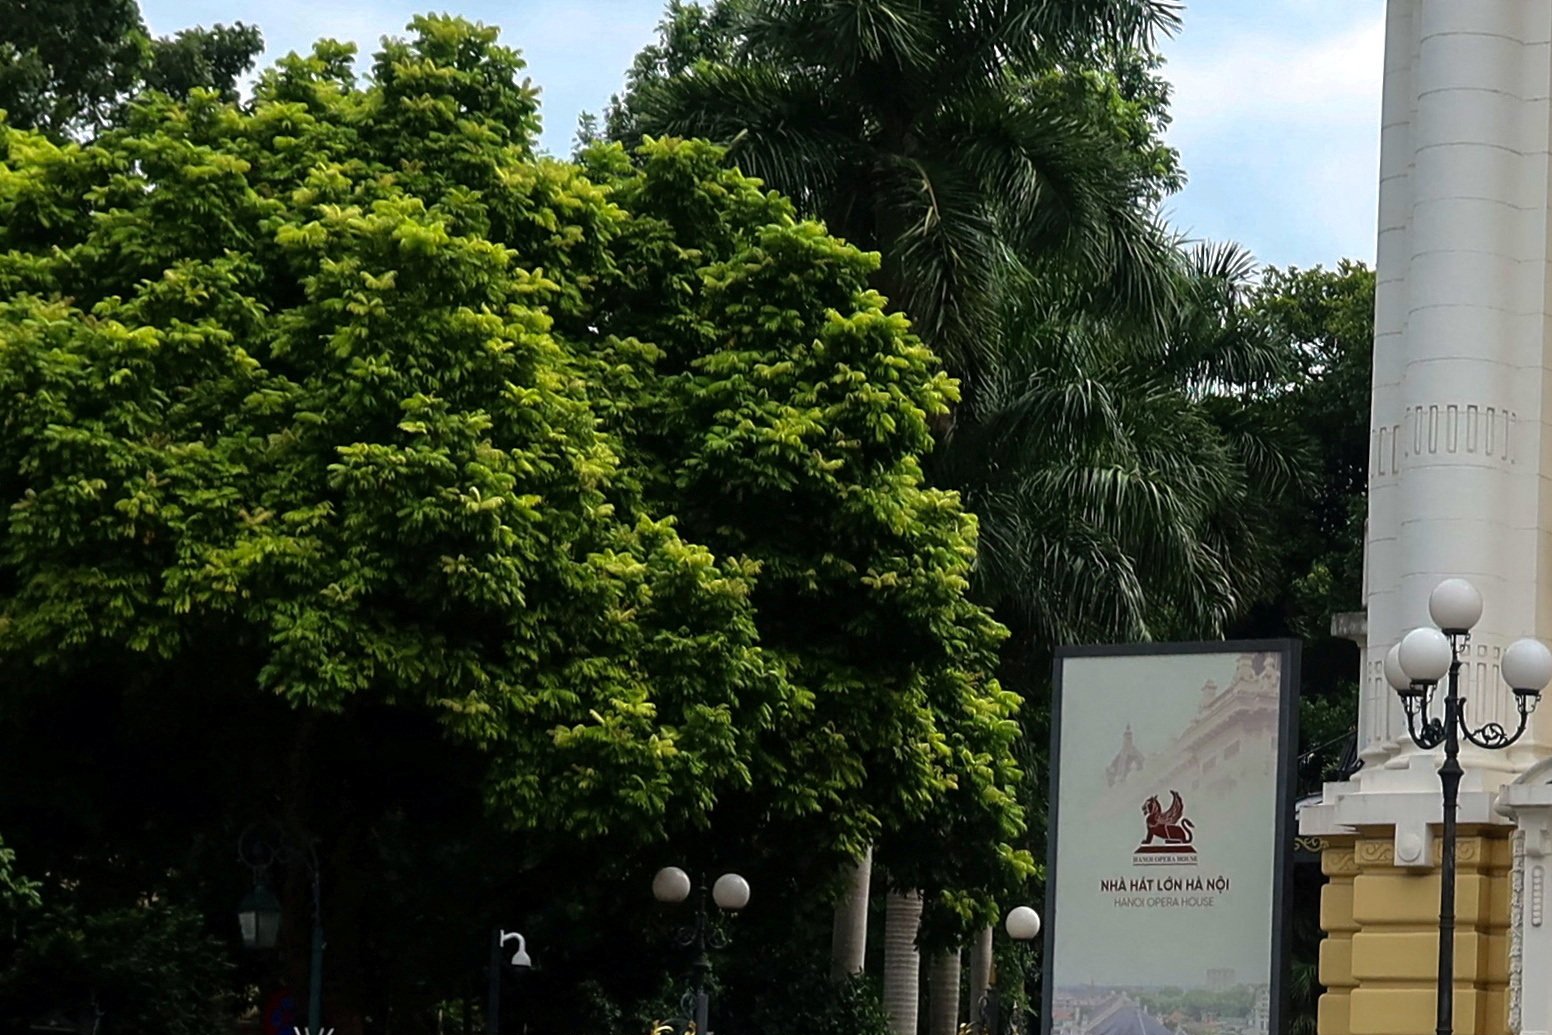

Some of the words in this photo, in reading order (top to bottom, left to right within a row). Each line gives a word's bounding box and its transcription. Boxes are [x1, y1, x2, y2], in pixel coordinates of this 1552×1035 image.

[1154, 856, 1176, 864] OPERA
[1100, 876, 1127, 892] NHÀ
[1130, 876, 1154, 892] HÁT
[1157, 876, 1182, 892] LỚN
[1185, 876, 1203, 891] HÀ
[1206, 875, 1230, 894] NỘI
[1114, 898, 1146, 908] HANOI
[1147, 897, 1179, 908] OPERA
[1181, 897, 1214, 907] HOUSE
